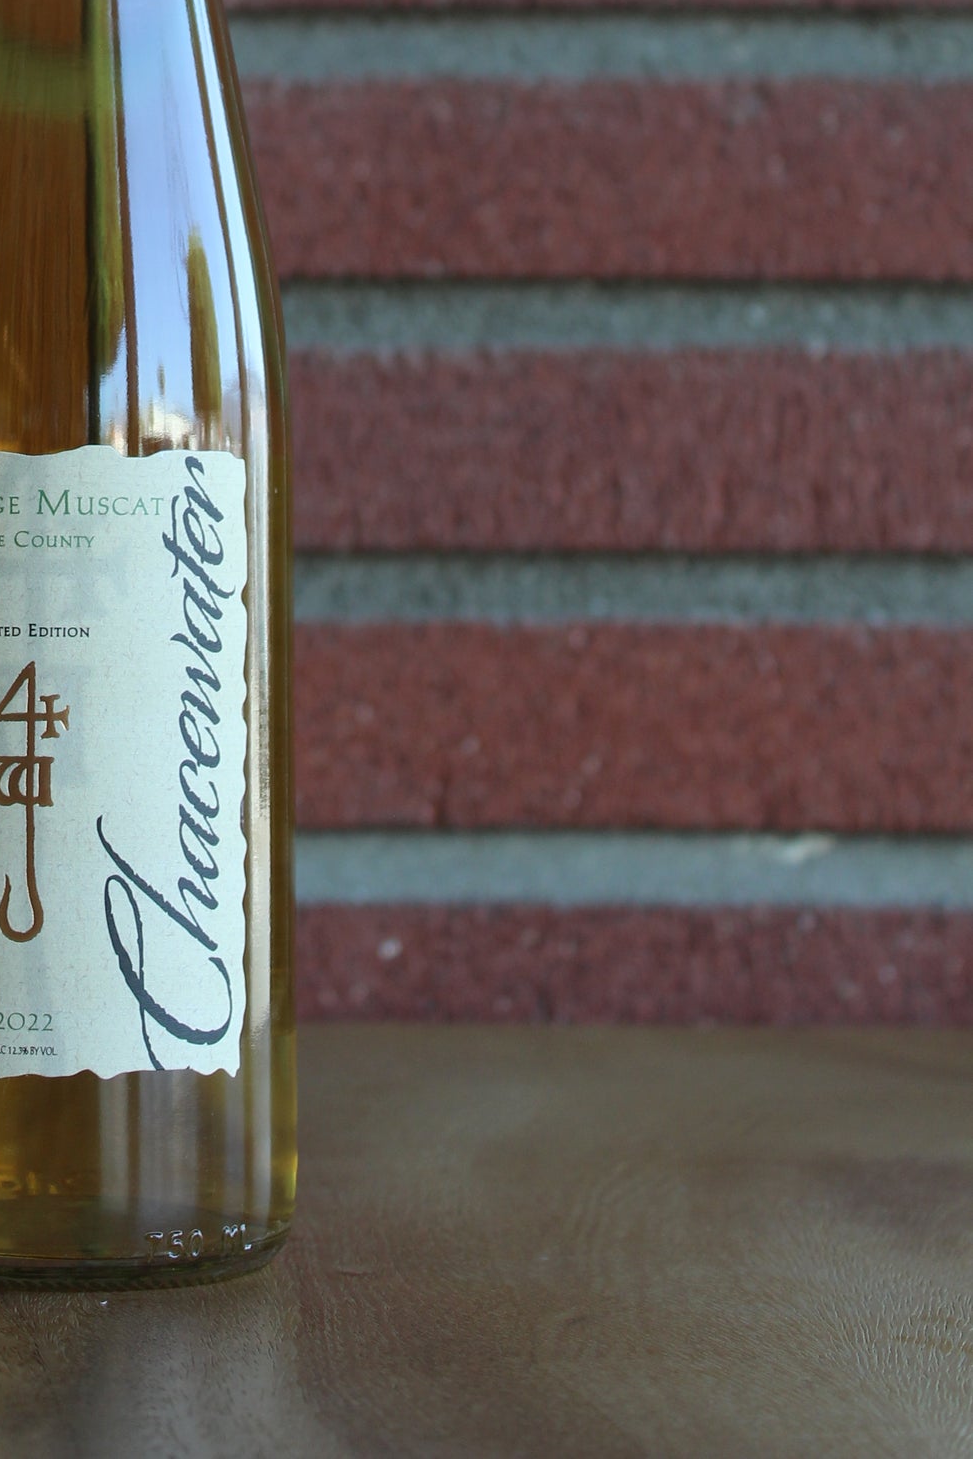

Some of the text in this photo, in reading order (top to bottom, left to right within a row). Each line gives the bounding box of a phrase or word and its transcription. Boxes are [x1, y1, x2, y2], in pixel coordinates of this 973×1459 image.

[36, 489, 165, 516] MUSCAT
[13, 530, 95, 549] COUNTY
[28, 623, 90, 638] EDITION
[95, 456, 236, 1070] Chacewater
[30, 1046, 39, 1055] BY
